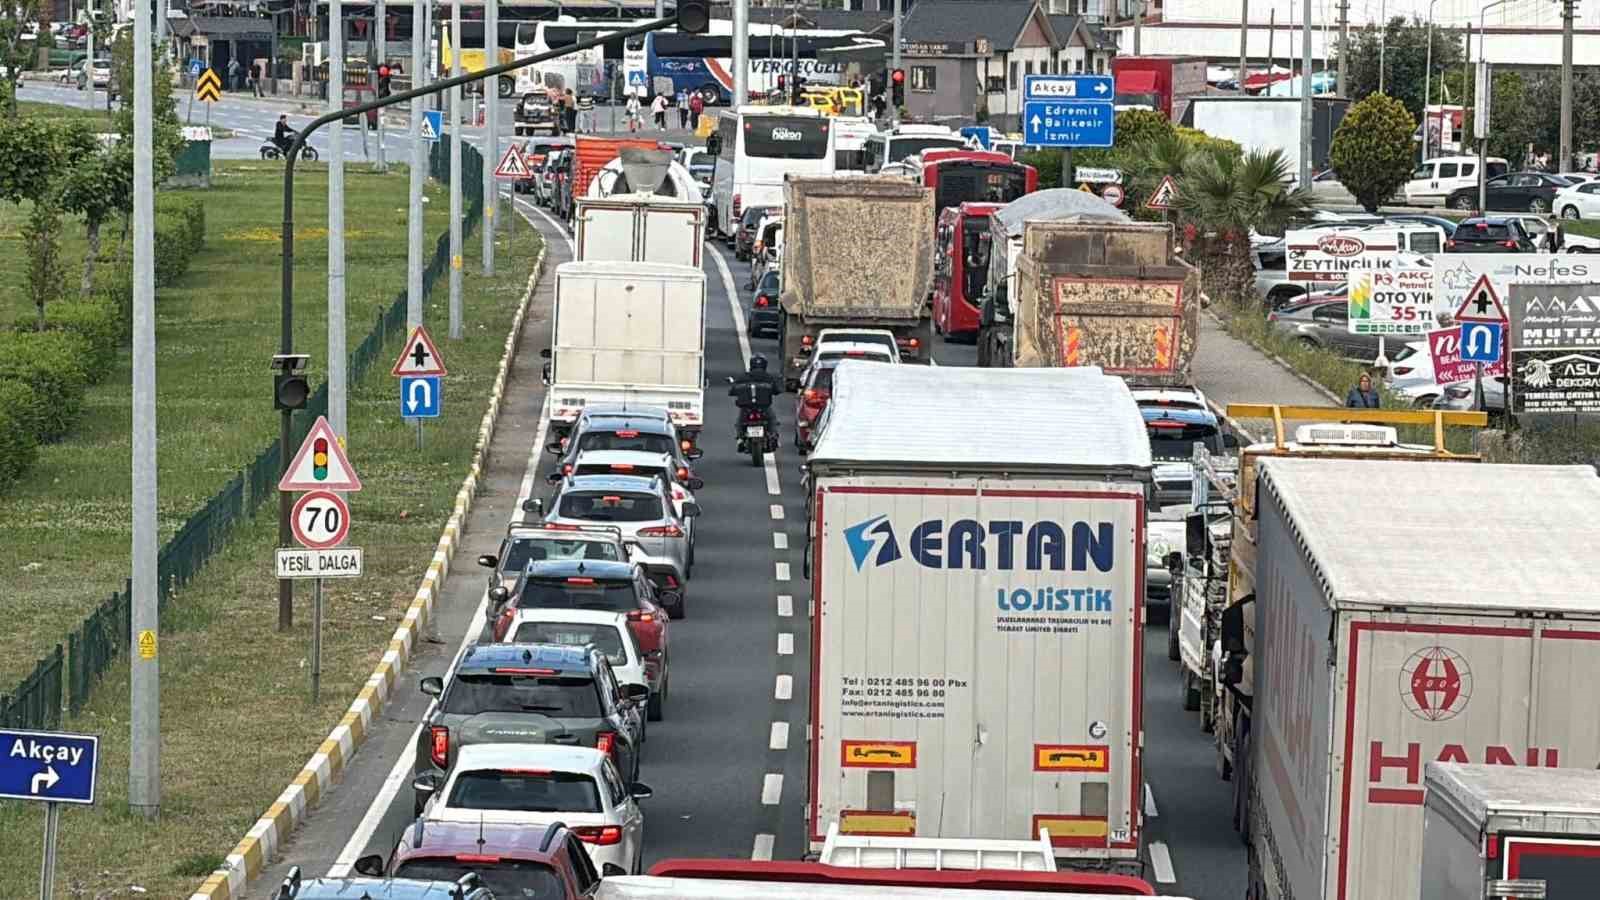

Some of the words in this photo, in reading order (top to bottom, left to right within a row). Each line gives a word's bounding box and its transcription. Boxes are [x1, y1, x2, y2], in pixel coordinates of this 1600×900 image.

[1045, 105, 1099, 115] Edremit
[1374, 292, 1407, 304] OTO
[1391, 306, 1416, 320] 35
[306, 507, 339, 533] 70
[909, 519, 1114, 573] ERTAN
[281, 553, 313, 572] YEŞİL
[319, 554, 358, 571] DALGA
[843, 678, 858, 686] Tel
[867, 678, 892, 687] 0212
[895, 678, 914, 687] 485
[917, 679, 929, 687] 96
[932, 679, 945, 688] 00
[1413, 678, 1461, 689] 2004
[842, 688, 864, 696] Fax:
[867, 689, 892, 697] 0212
[895, 689, 914, 698] 485
[917, 690, 929, 698] 96
[932, 690, 945, 698] 80
[841, 711, 945, 720] www.ertanlogistics.com
[9, 738, 84, 766] Akçay
[1113, 830, 1127, 842] TR
